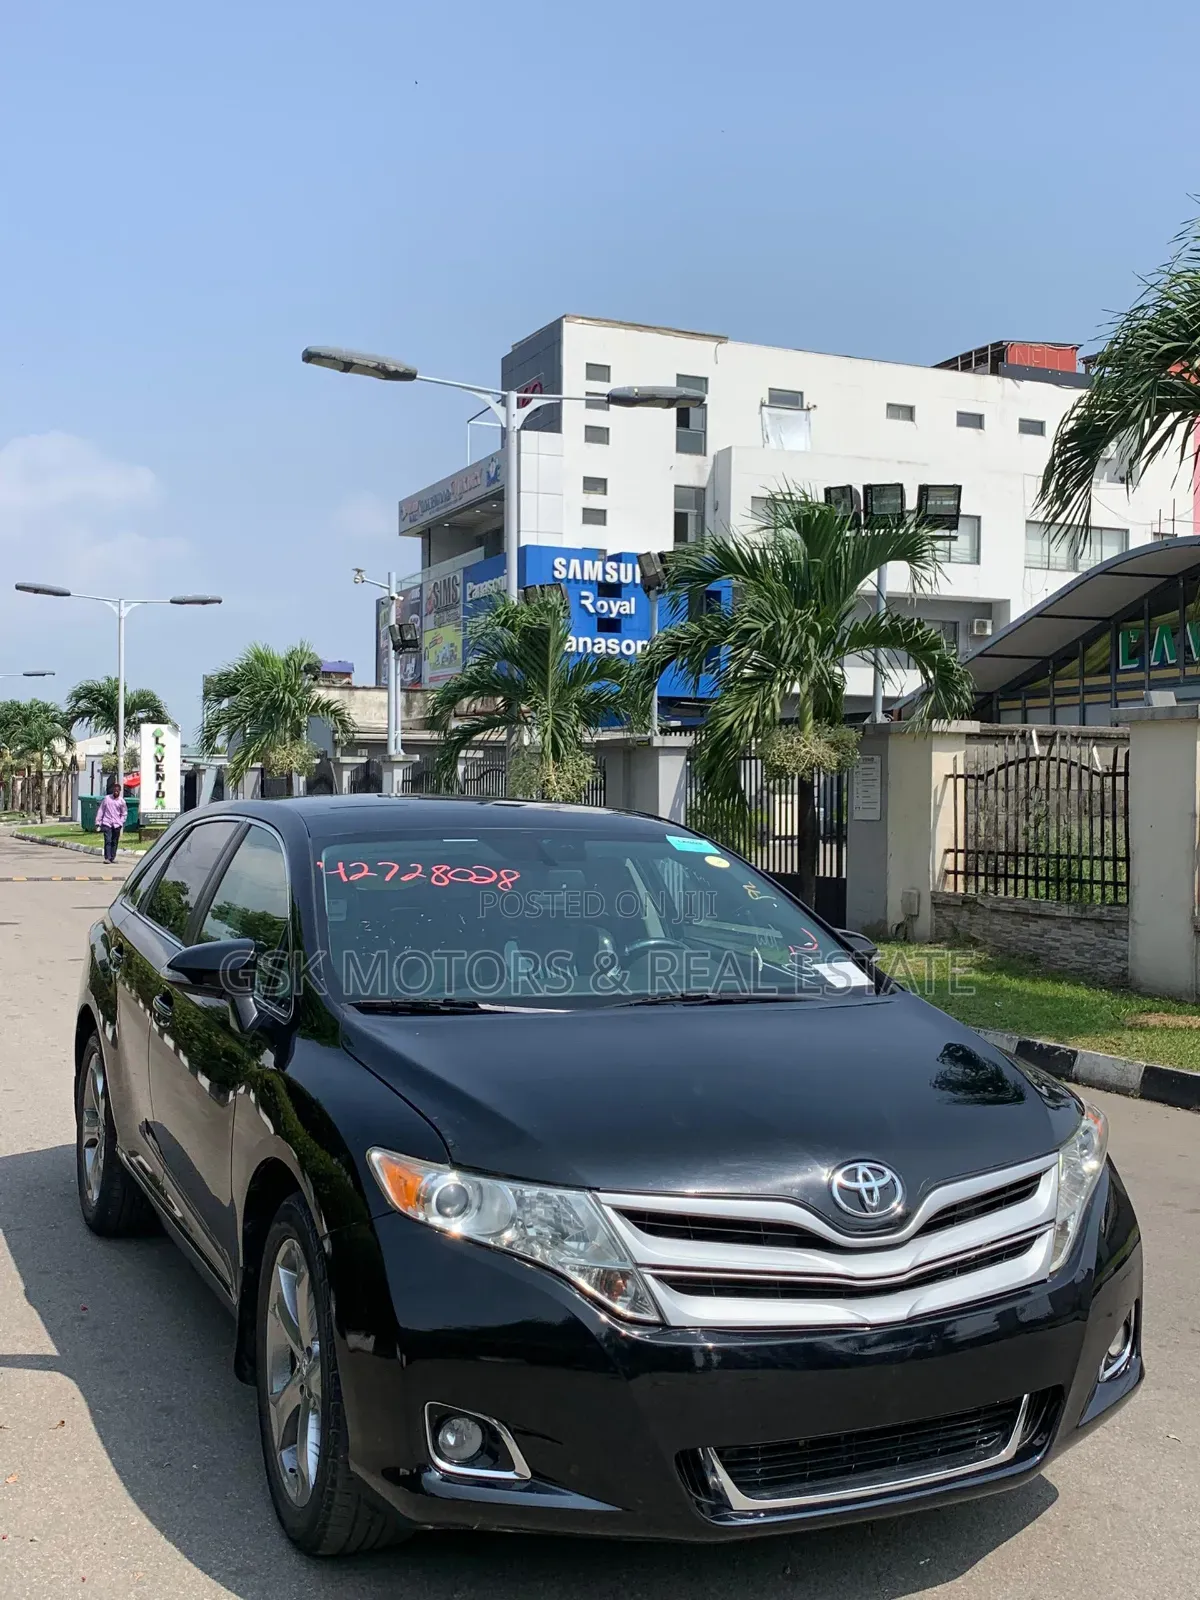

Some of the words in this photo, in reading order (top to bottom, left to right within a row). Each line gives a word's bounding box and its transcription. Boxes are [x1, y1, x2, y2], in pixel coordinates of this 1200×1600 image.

[433, 575, 460, 609] SIMS
[580, 591, 635, 618] Royal
[317, 861, 520, 891] 42728028
